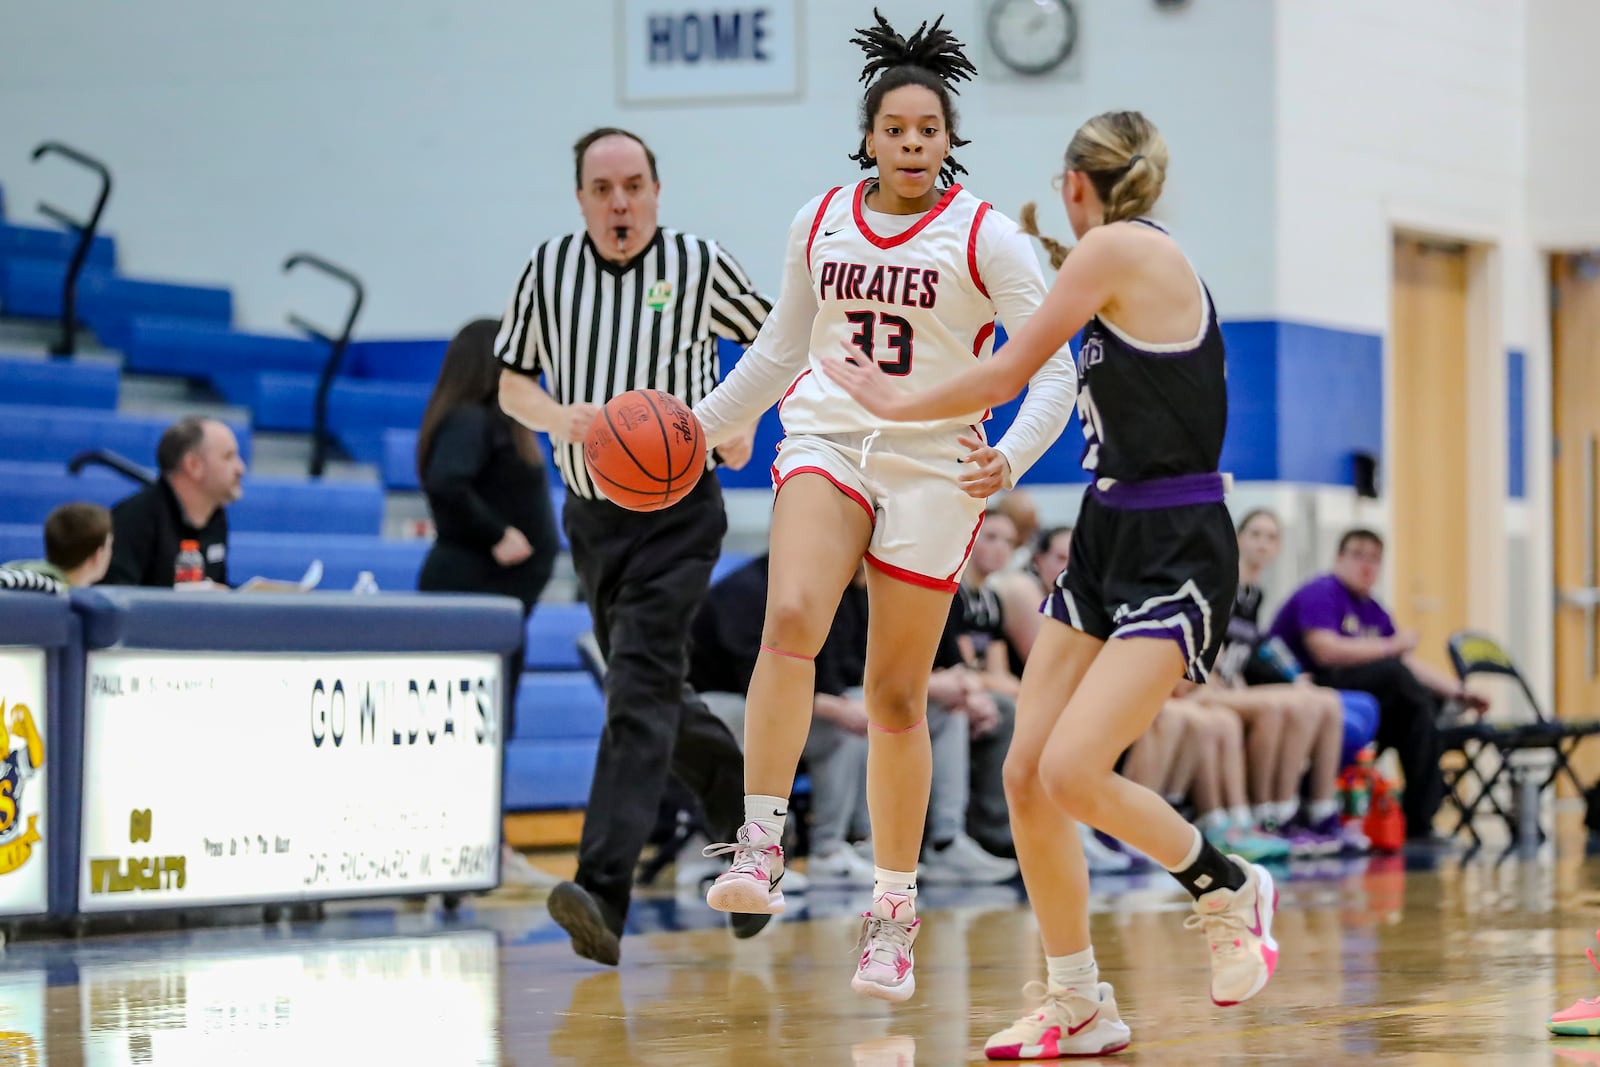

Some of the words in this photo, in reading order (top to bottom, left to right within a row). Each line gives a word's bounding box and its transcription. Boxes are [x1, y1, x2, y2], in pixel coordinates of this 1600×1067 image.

[648, 9, 772, 64] HOME
[820, 261, 939, 309] PIRATES
[844, 310, 914, 377] 33
[311, 679, 345, 748] GO
